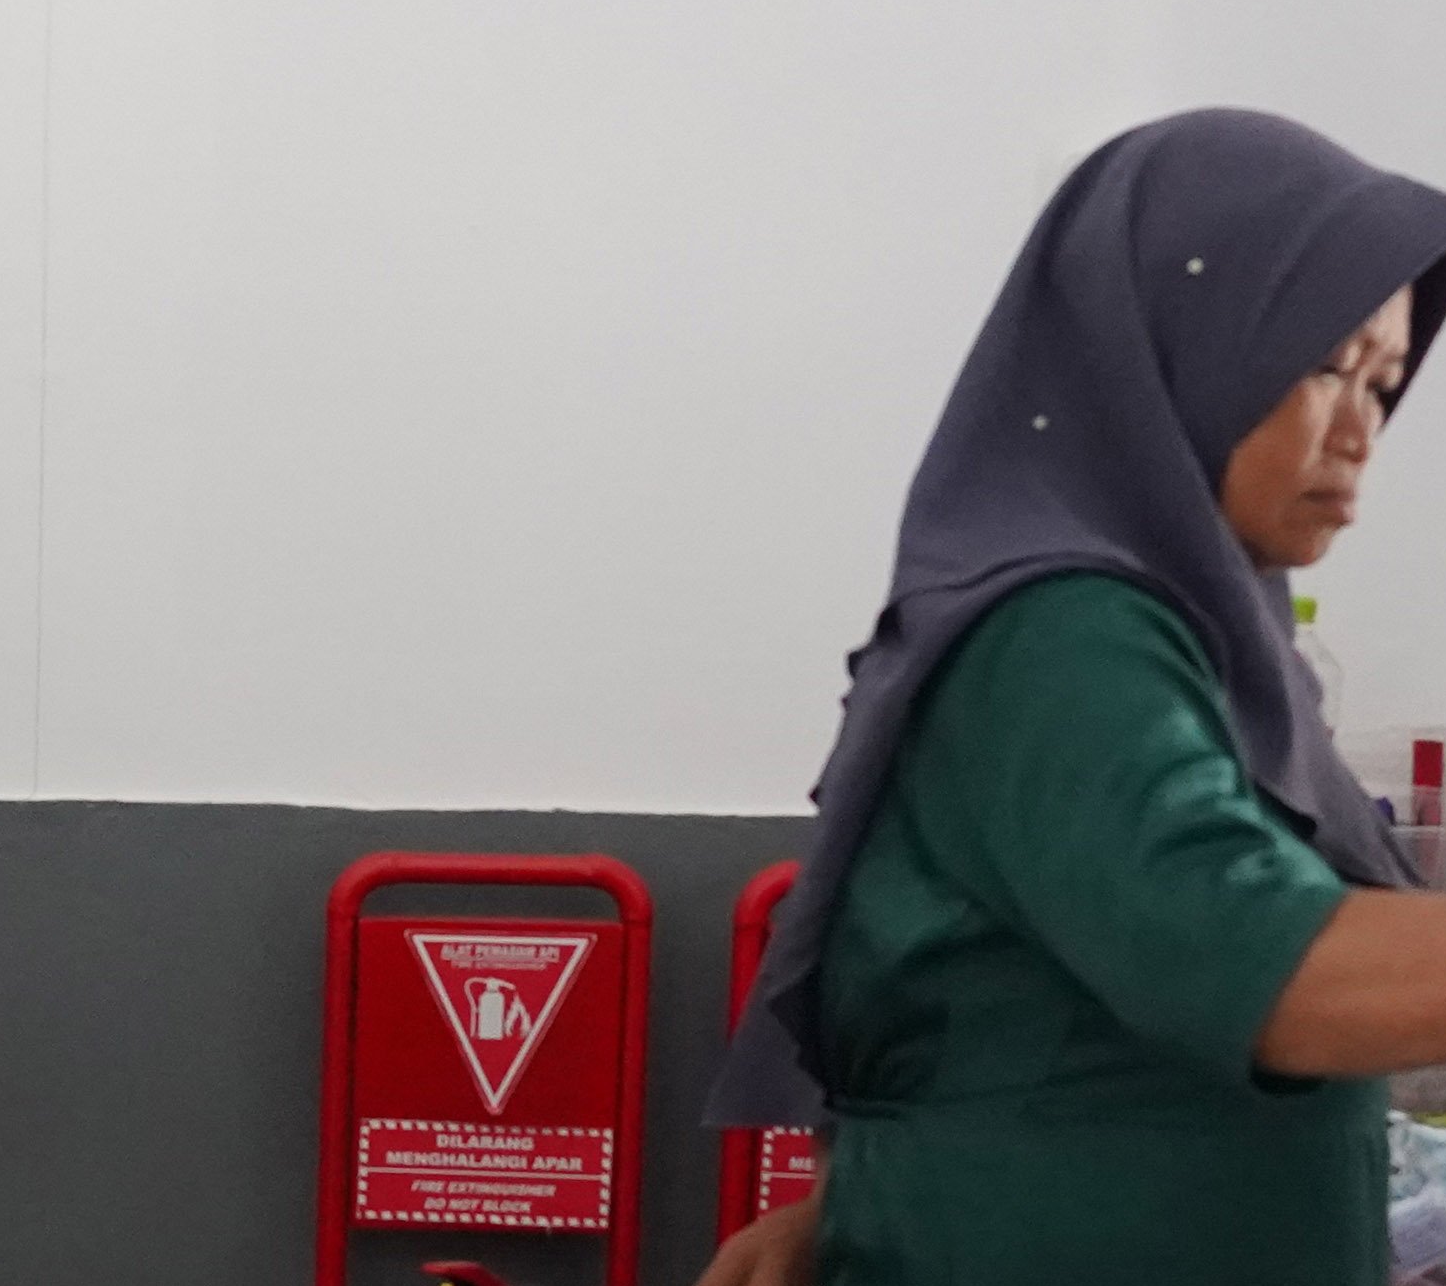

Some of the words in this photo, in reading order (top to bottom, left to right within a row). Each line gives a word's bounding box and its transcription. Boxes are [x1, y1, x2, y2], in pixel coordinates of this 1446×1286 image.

[435, 1134, 535, 1151] DILARANG
[385, 1150, 528, 1169] MENGHALANGI
[532, 1156, 583, 1172] APAR
